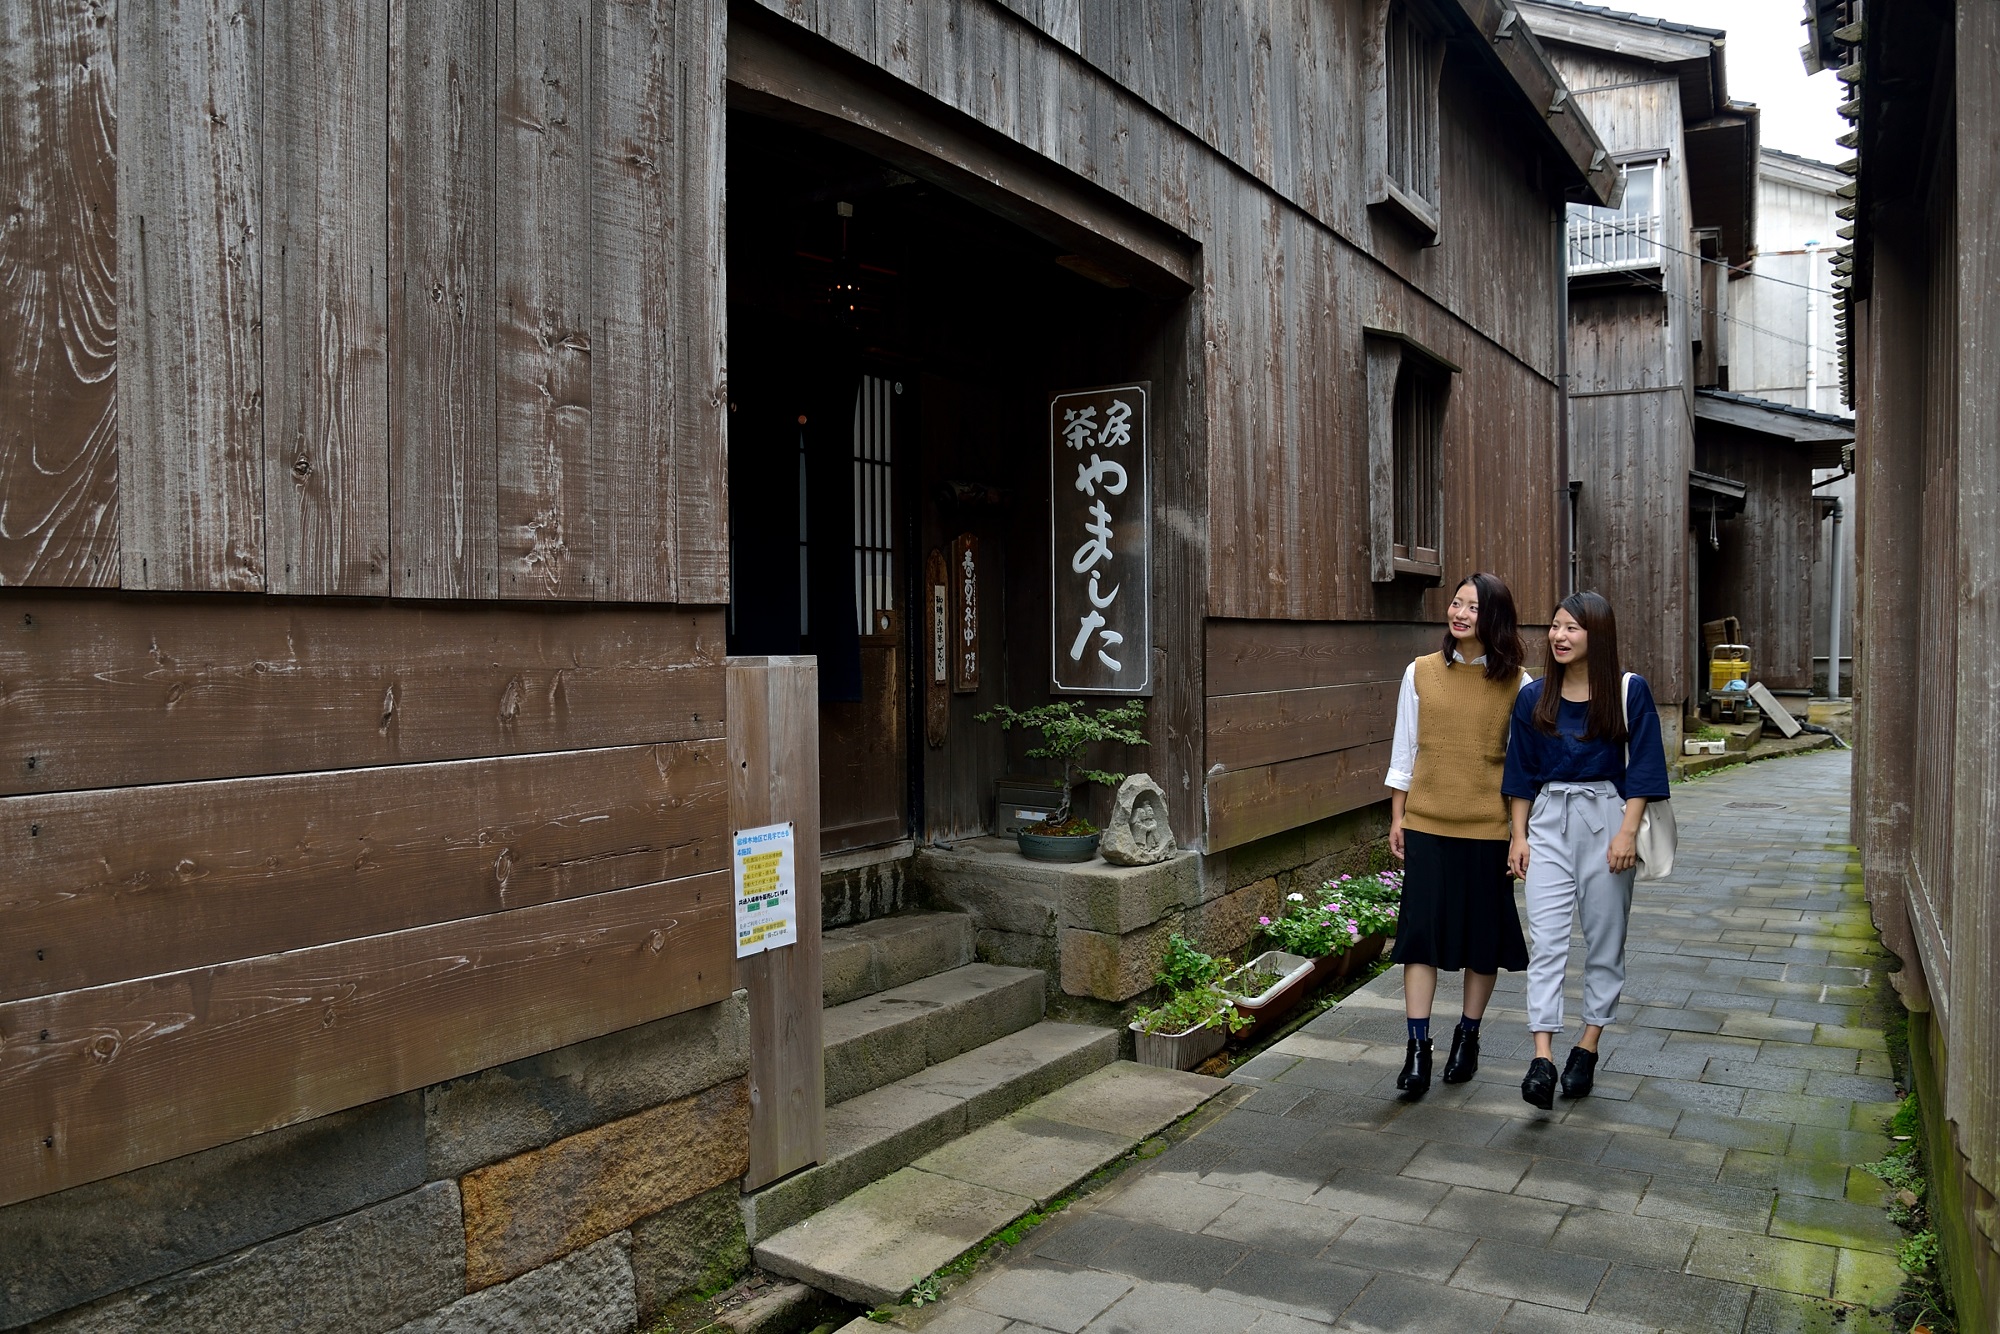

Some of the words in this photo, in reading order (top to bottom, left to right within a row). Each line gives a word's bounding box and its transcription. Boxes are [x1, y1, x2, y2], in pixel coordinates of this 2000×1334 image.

[1062, 400, 1132, 450] 茶房
[1070, 453, 1128, 672] やました
